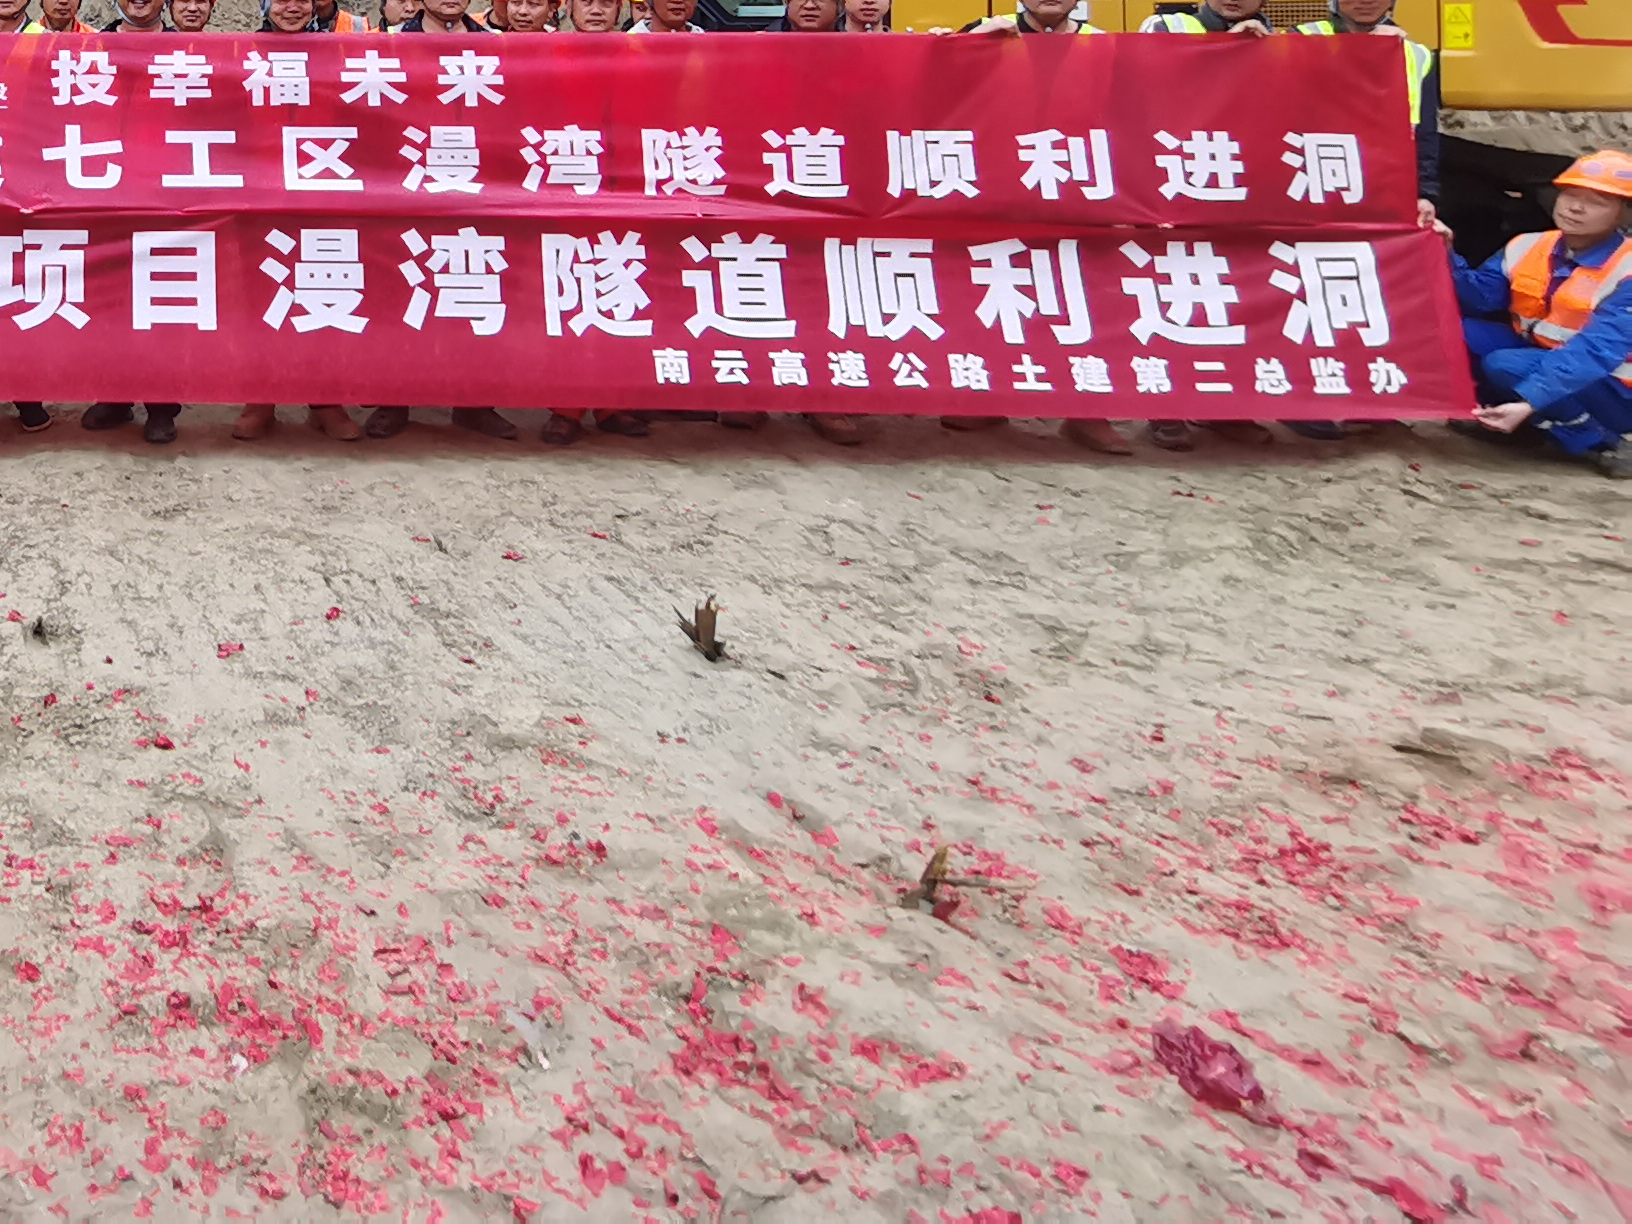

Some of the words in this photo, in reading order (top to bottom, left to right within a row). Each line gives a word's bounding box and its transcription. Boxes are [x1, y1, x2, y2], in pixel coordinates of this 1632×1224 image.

[50, 49, 506, 108] 投幸福未来
[653, 346, 1409, 395] 南云高速公路土建第二总监办
